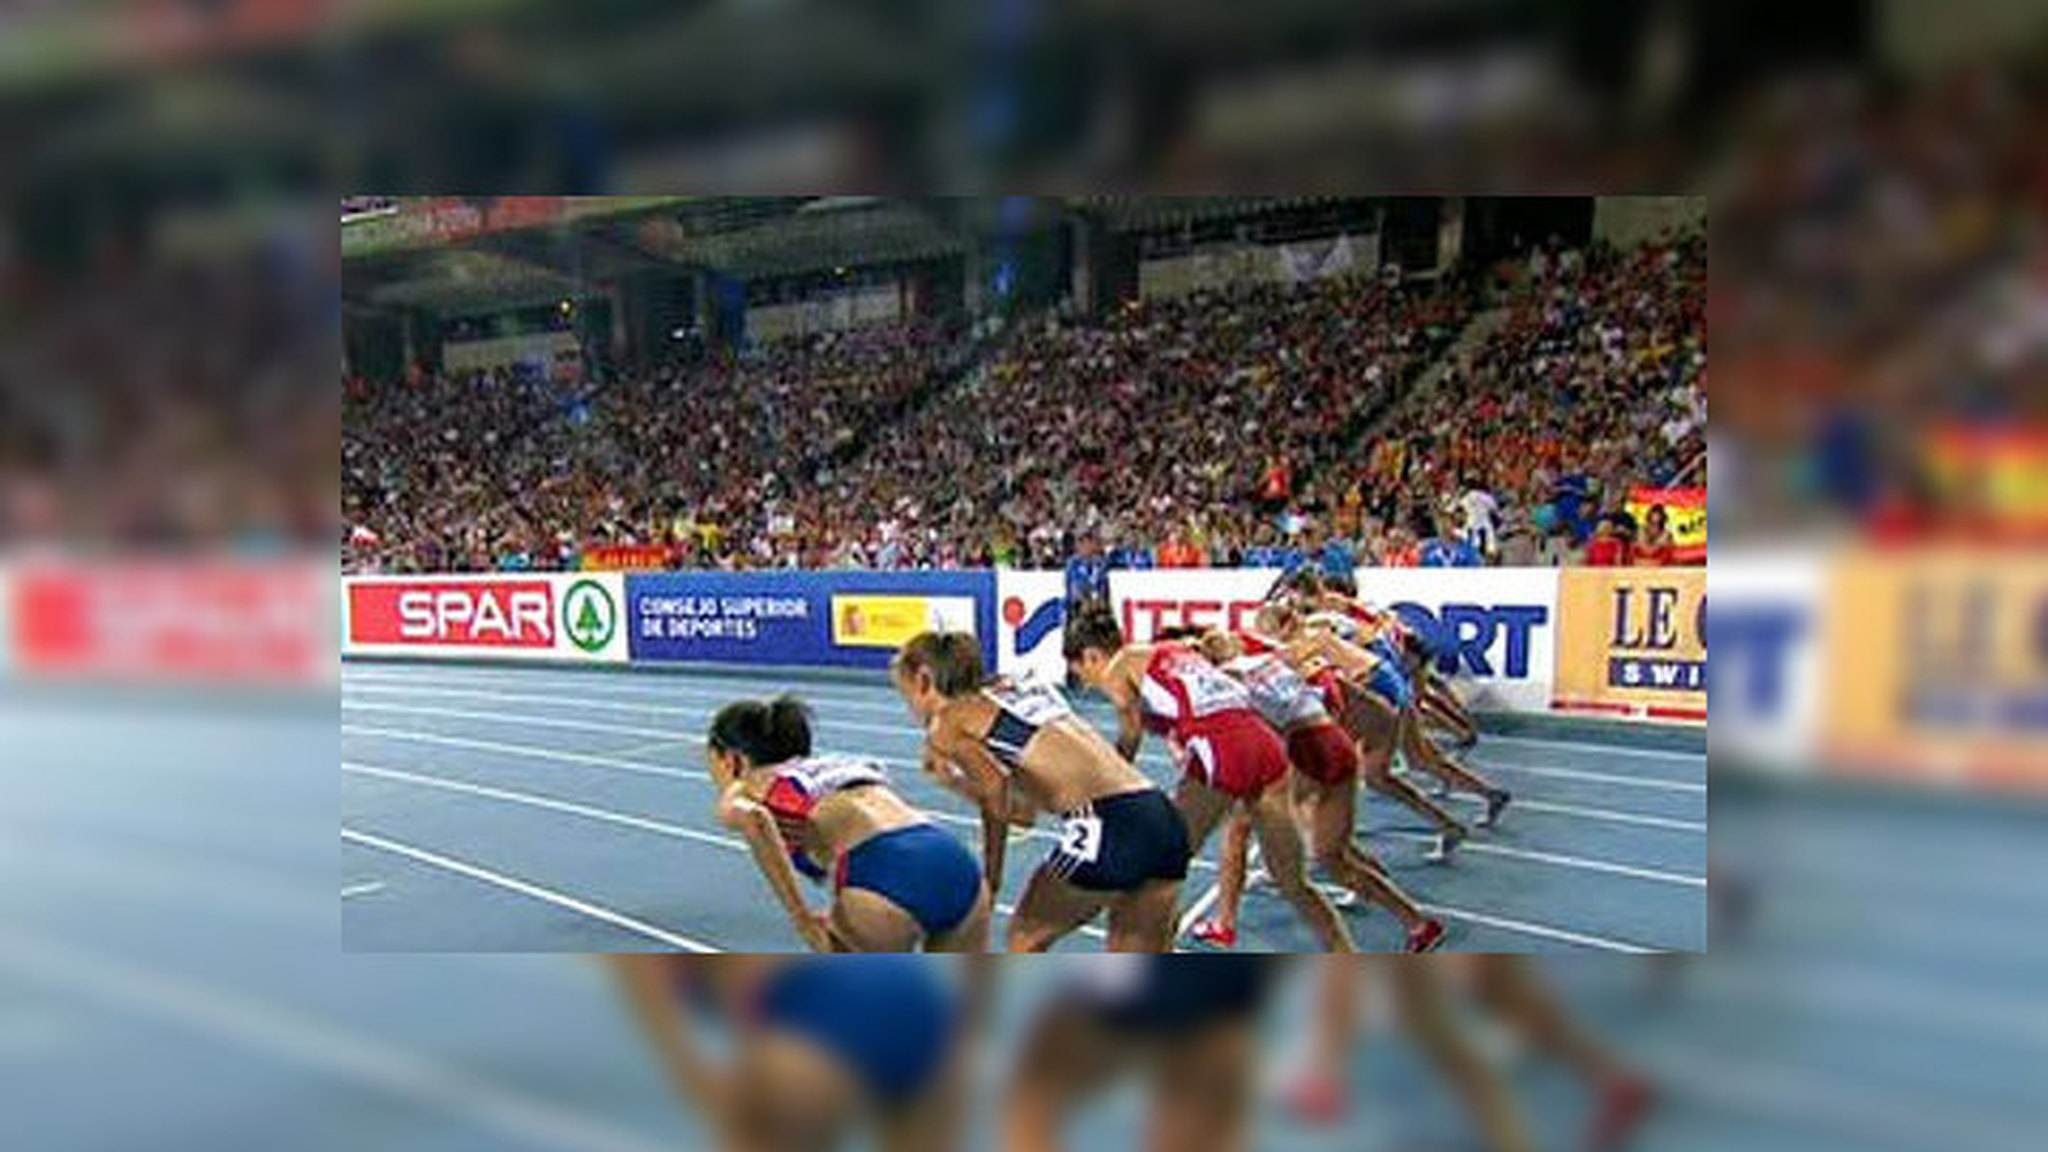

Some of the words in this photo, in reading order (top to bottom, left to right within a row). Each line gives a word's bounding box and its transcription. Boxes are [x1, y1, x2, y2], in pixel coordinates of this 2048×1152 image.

[399, 590, 552, 639] SPAR
[639, 596, 718, 617] CONSEJO
[720, 597, 808, 619] SUPERIOR
[1612, 587, 1678, 649] LE
[641, 617, 664, 638] DE
[668, 618, 757, 640] DEPORTES
[1070, 822, 1089, 851] 2
